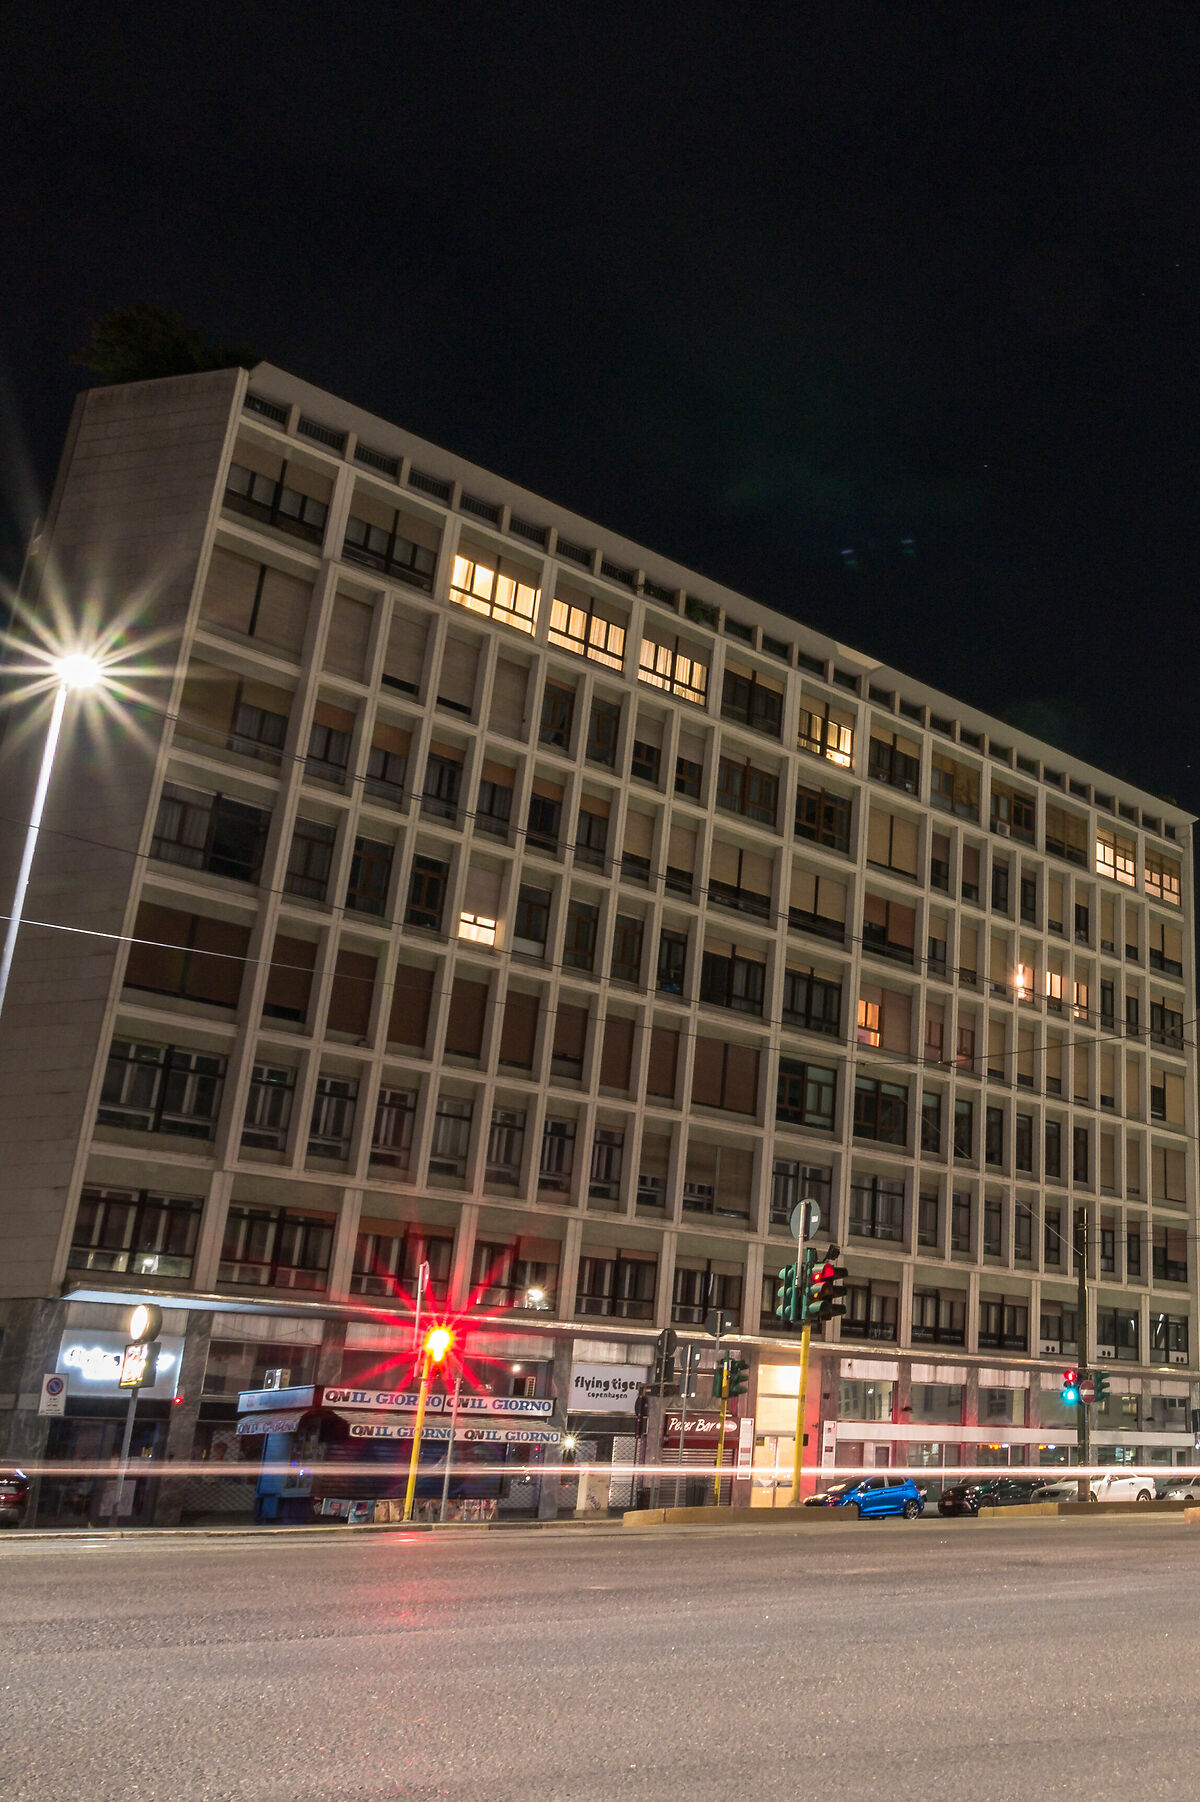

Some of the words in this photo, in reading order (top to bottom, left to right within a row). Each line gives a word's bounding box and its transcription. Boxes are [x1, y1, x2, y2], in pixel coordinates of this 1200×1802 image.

[574, 1376, 611, 1391] flying
[587, 1391, 628, 1400] copenhagen
[491, 1399, 552, 1412] GIORNO
[696, 1418, 717, 1432] Bar
[505, 1431, 559, 1442] GIORNO
